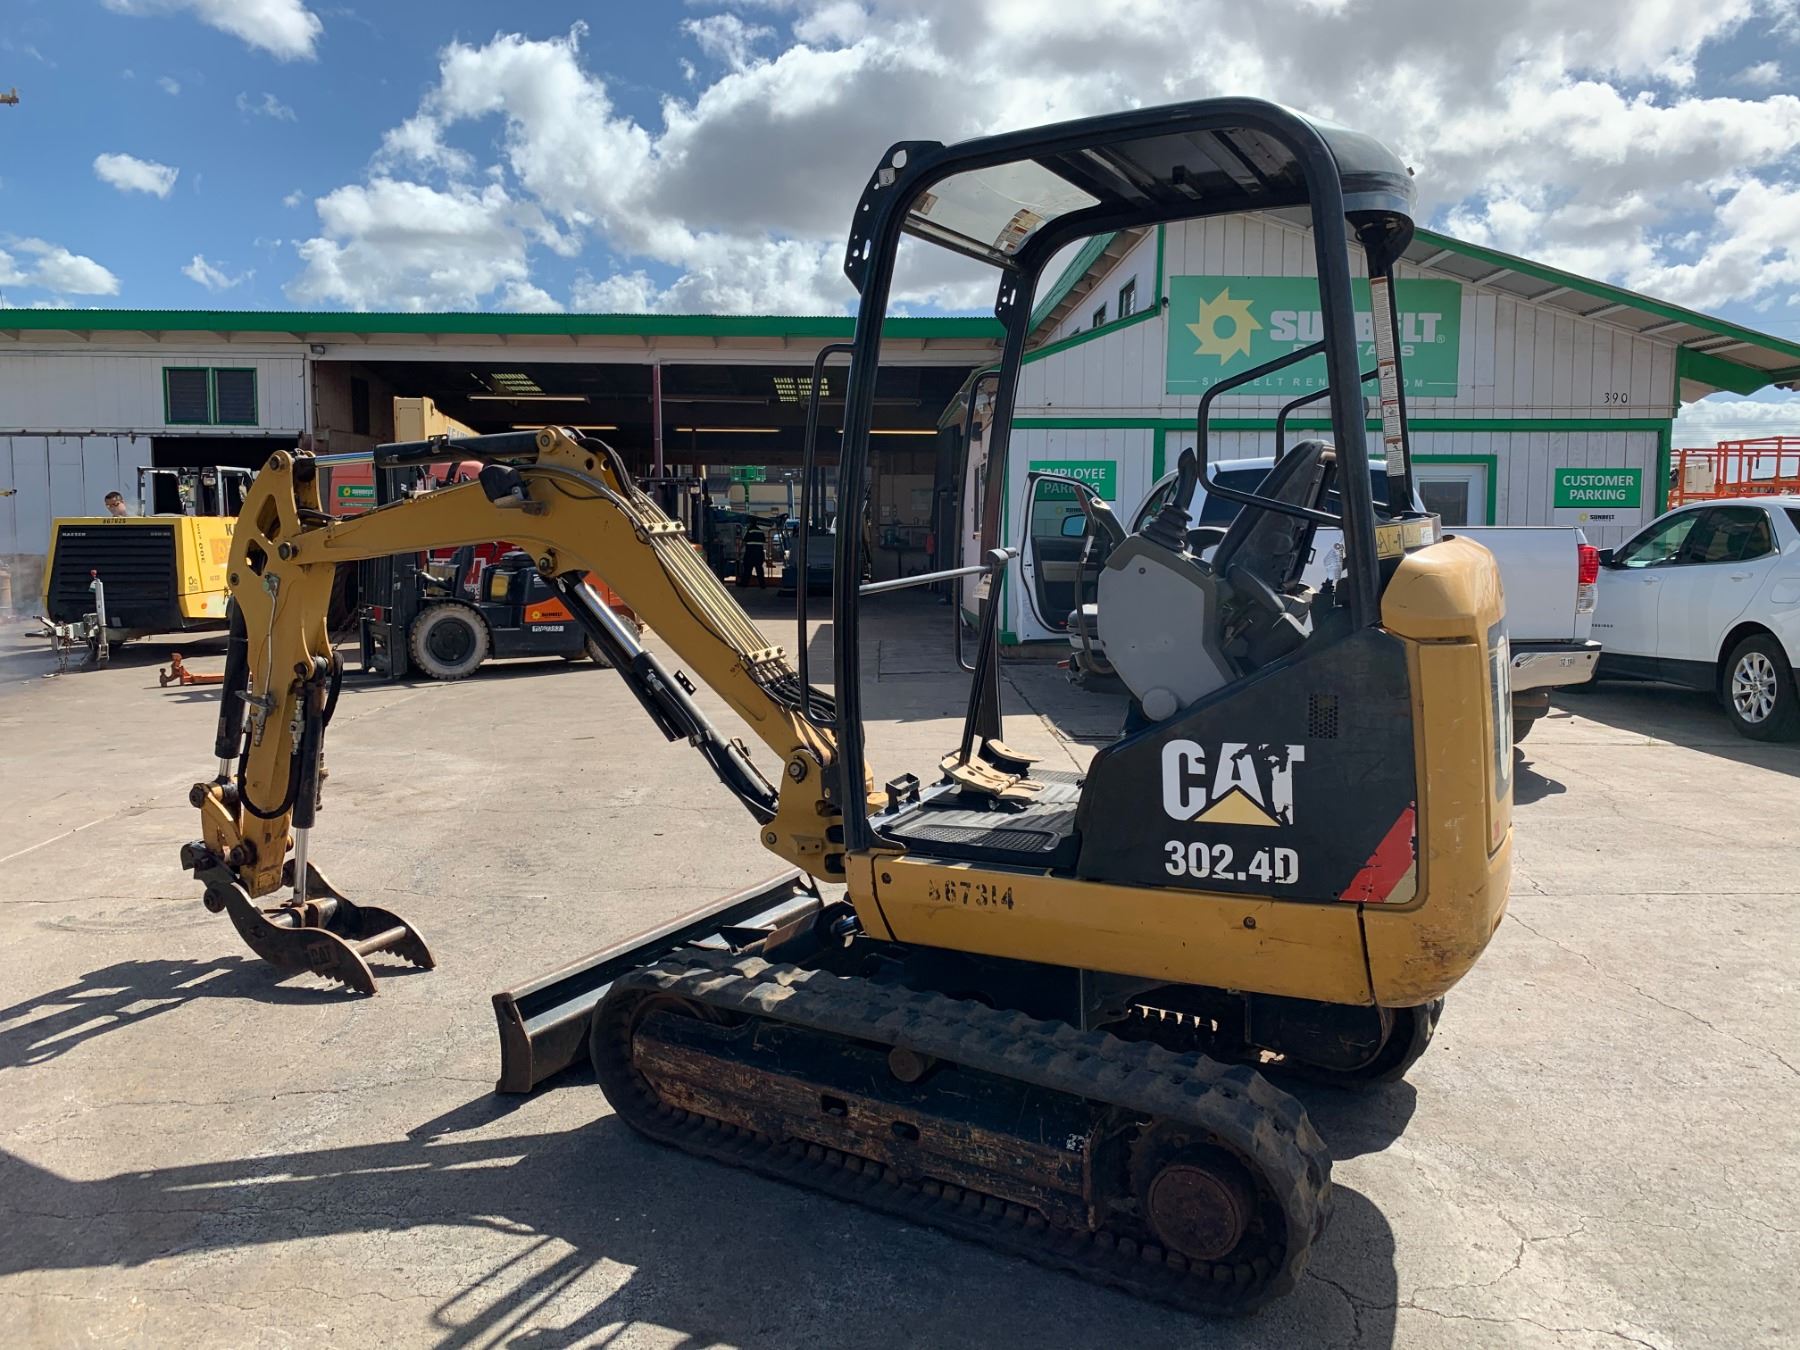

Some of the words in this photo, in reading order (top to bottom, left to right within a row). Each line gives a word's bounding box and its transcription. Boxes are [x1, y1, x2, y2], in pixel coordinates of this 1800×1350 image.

[1269, 310, 1442, 342] SUBLT
[1604, 392, 1628, 404] 390
[1562, 475, 1634, 487] CUSTOMER
[1044, 482, 1100, 494] PARG
[1569, 489, 1626, 501] PARKING
[1161, 739, 1305, 825] CAT
[1164, 840, 1299, 884] 302.4D
